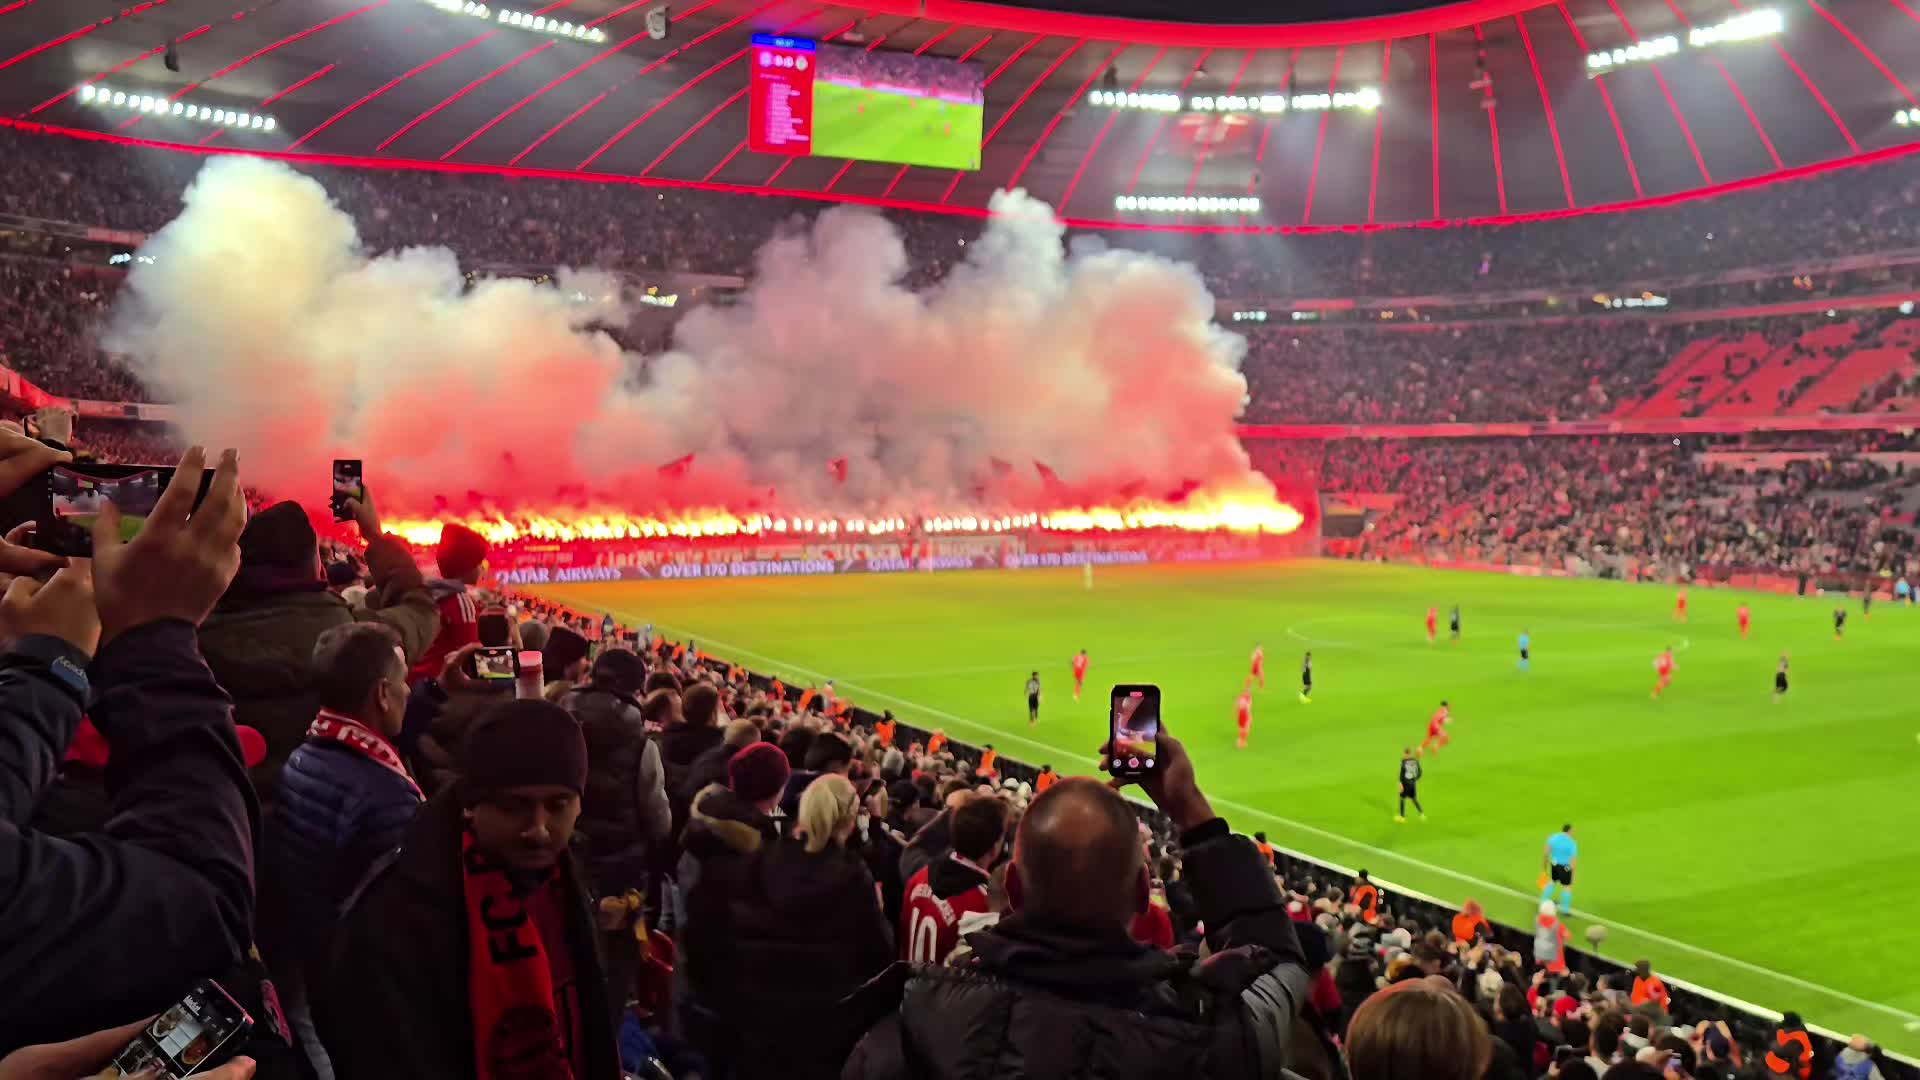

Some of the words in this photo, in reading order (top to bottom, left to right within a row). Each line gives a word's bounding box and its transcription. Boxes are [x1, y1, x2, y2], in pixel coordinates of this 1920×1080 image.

[496, 567, 550, 585] QATAR
[556, 565, 622, 583] AIRWAYS
[661, 563, 702, 578] OVER
[706, 562, 728, 577] 170
[730, 557, 836, 577] DESTINATIONS
[910, 906, 938, 964] 10
